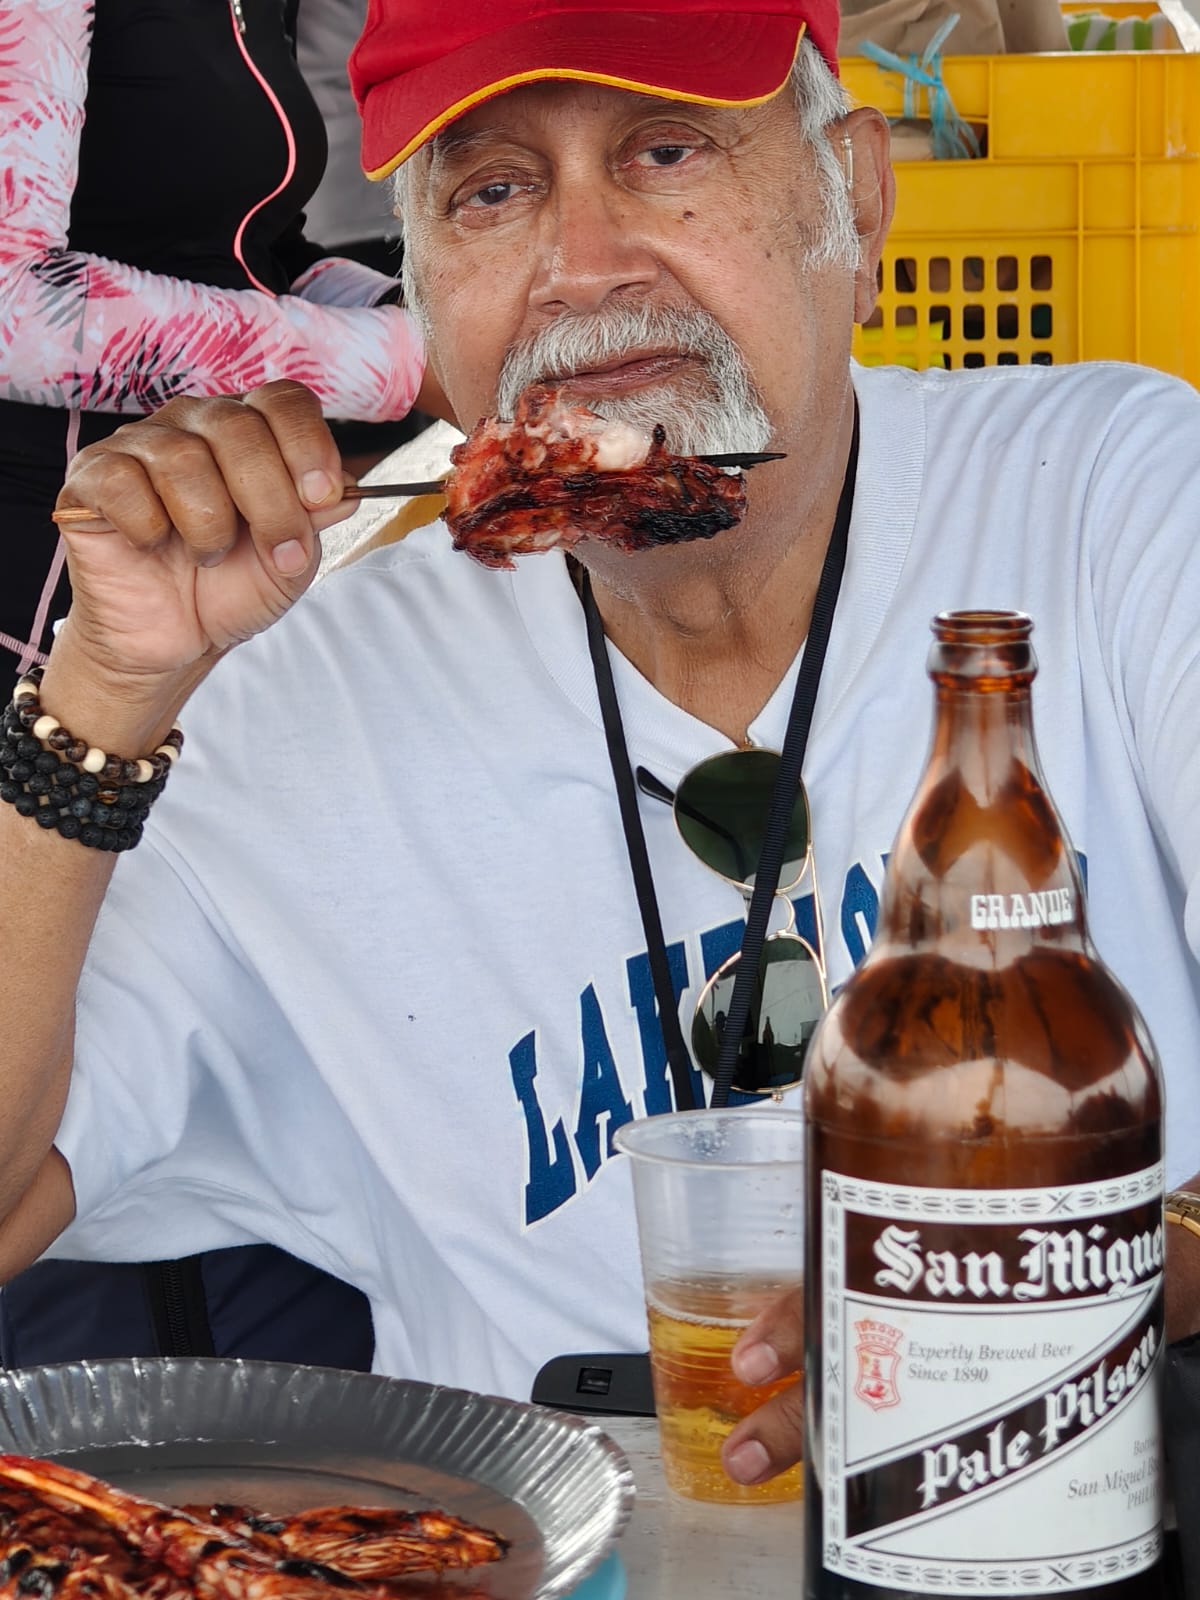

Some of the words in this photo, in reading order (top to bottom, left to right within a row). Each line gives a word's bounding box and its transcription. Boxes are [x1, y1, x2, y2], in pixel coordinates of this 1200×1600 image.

[970, 888, 1074, 930] GRANDE
[872, 1224, 1011, 1299] San
[1012, 1223, 1163, 1300] Migue
[907, 1340, 973, 1363] Expertly
[978, 1343, 1039, 1361] Brewed
[1042, 1342, 1073, 1359] Beer
[907, 1363, 948, 1382] Since
[952, 1366, 989, 1383] 1890
[916, 1420, 1033, 1510] Pale
[1038, 1324, 1156, 1453] Pilsen
[1067, 1478, 1098, 1499] San
[1102, 1460, 1146, 1494] Miguel
